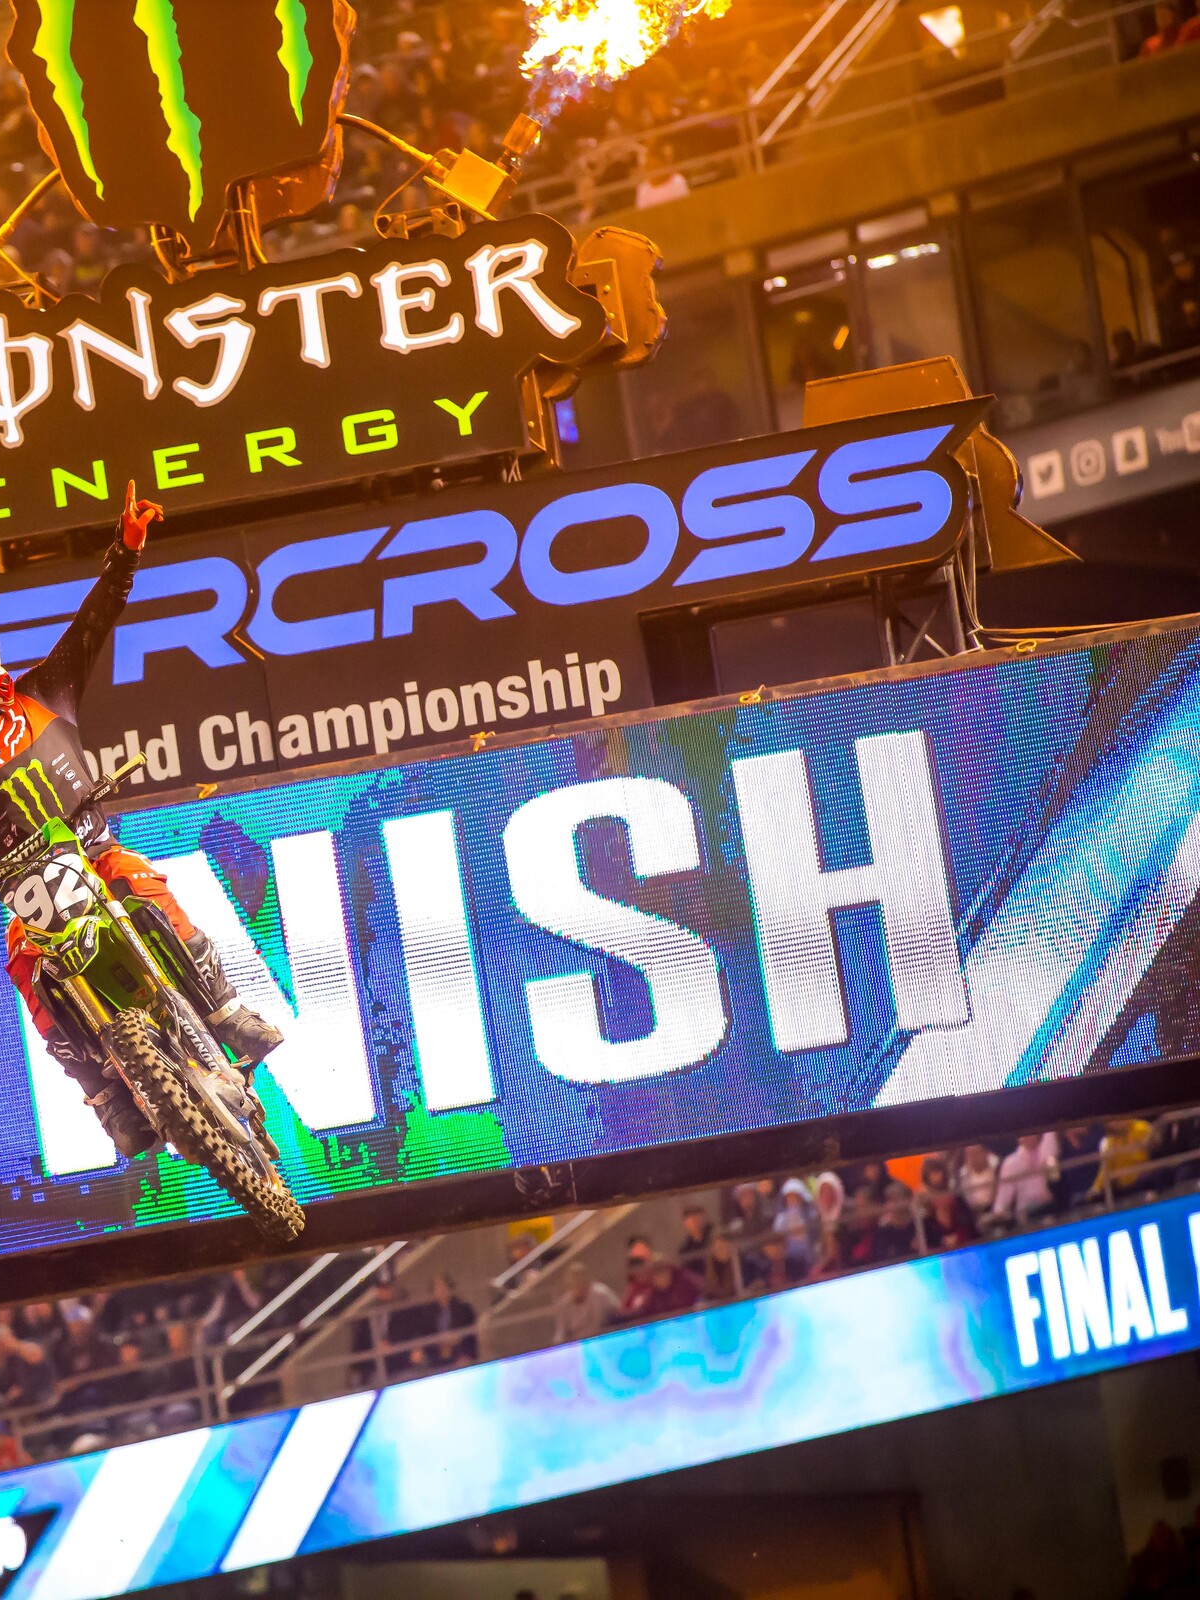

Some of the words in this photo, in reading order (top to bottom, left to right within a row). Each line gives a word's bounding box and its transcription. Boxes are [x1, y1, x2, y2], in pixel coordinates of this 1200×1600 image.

[197, 652, 623, 771] Championship
[13, 853, 91, 931] 92
[1005, 1222, 1189, 1368] FINAL
